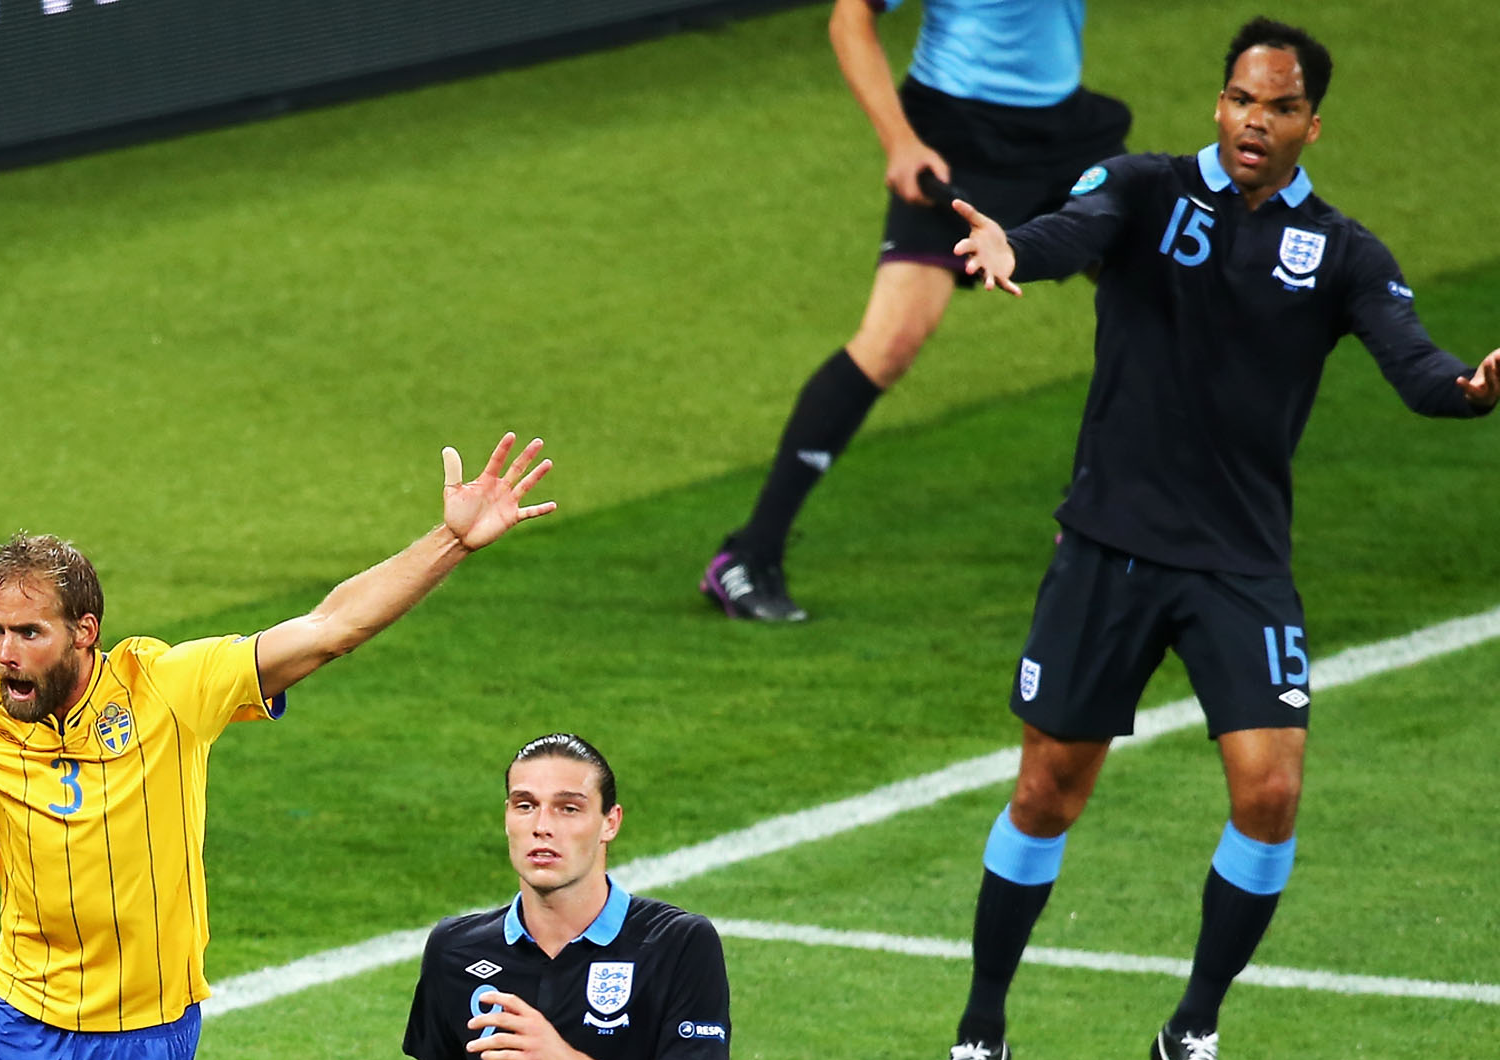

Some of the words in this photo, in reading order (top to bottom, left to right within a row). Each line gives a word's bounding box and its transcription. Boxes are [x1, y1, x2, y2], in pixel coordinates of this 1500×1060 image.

[1159, 197, 1215, 267] 15
[1264, 625, 1311, 687] 15
[48, 758, 83, 814] 3
[470, 984, 503, 1040] 9
